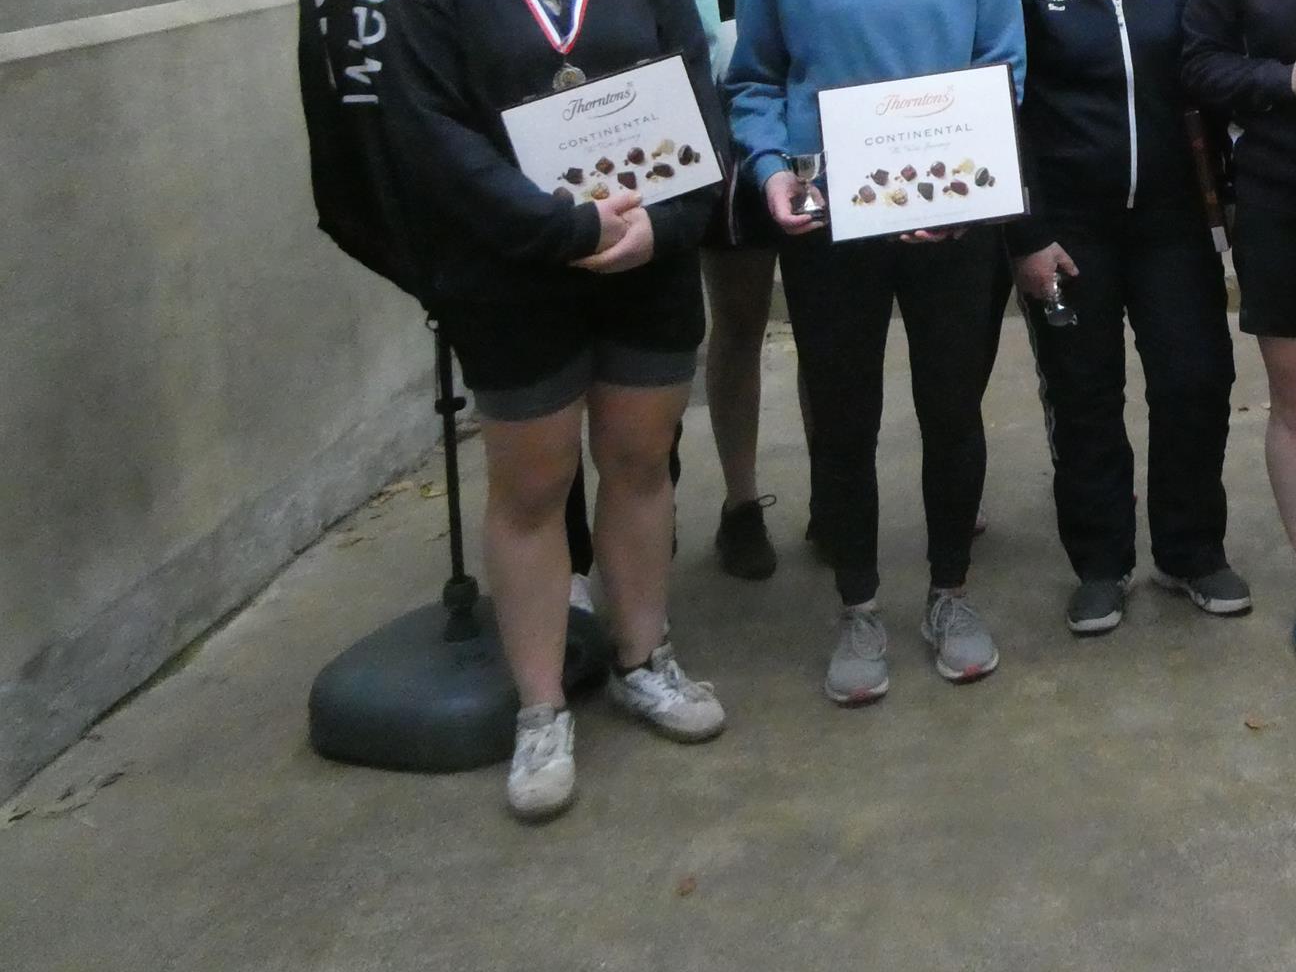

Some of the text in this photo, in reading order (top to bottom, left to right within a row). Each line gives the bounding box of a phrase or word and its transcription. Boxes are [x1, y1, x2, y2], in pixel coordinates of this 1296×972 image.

[562, 89, 636, 121] Thorntons
[876, 92, 954, 117] Thorntons
[559, 113, 659, 150] CONTINENTAL
[864, 123, 973, 146] CONTINENTAL
